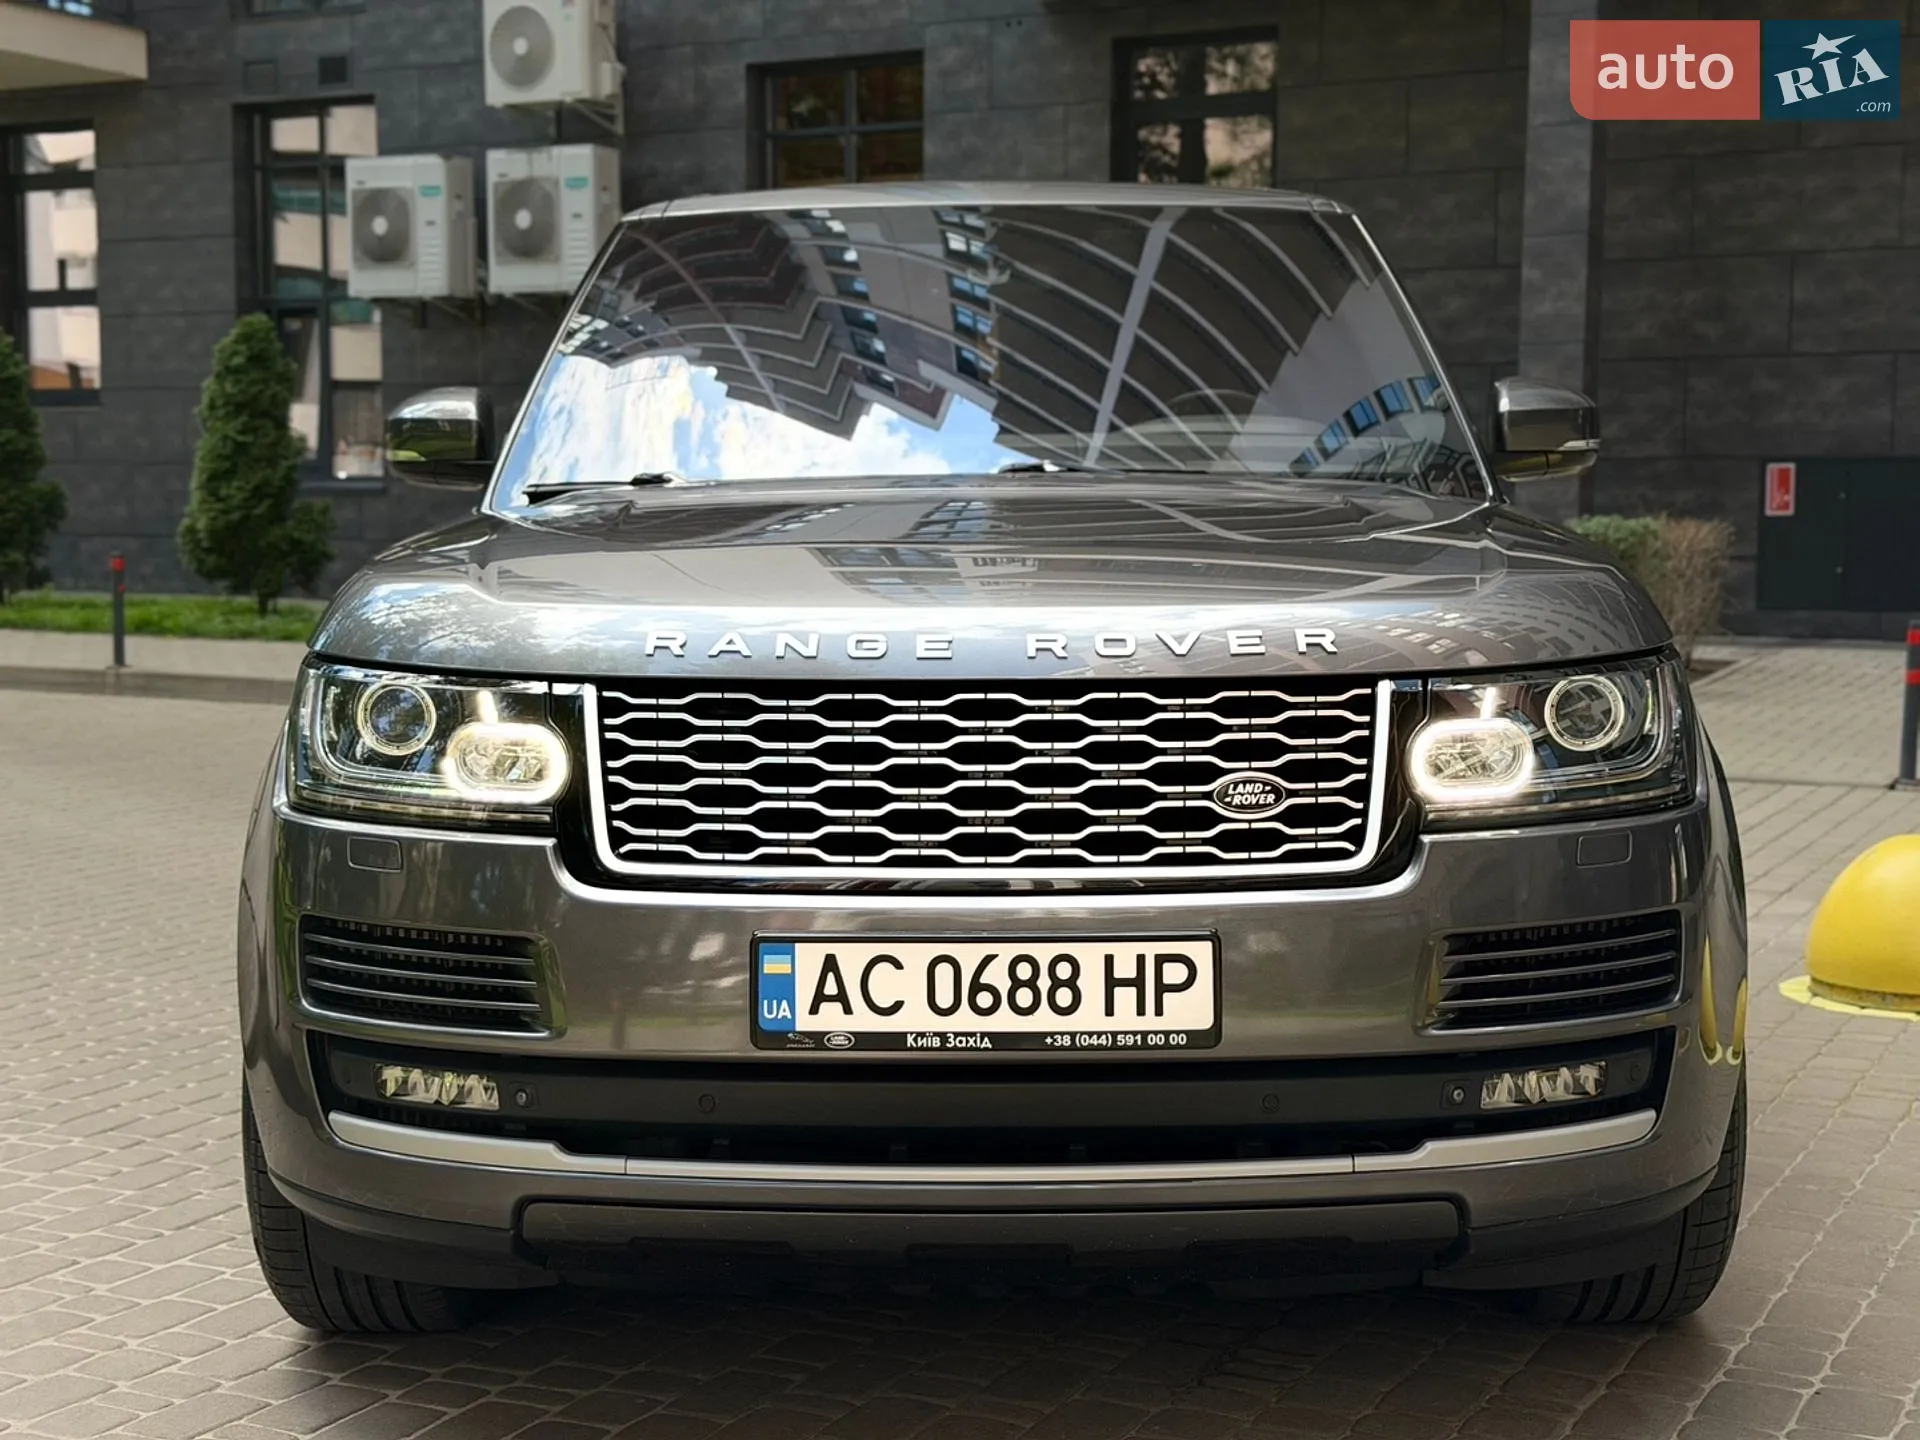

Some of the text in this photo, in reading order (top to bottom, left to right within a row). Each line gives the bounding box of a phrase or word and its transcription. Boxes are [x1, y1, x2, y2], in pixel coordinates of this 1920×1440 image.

[644, 627, 1339, 660] RANGE ROVER
[1228, 783, 1264, 795] LAND
[1231, 794, 1276, 806] ROVER
[807, 953, 1198, 1018] AC 0688 HP
[763, 999, 792, 1020] UA
[906, 1032, 992, 1049] Київ Захід
[1044, 1033, 1187, 1047] +38 (044) 591 00 00
